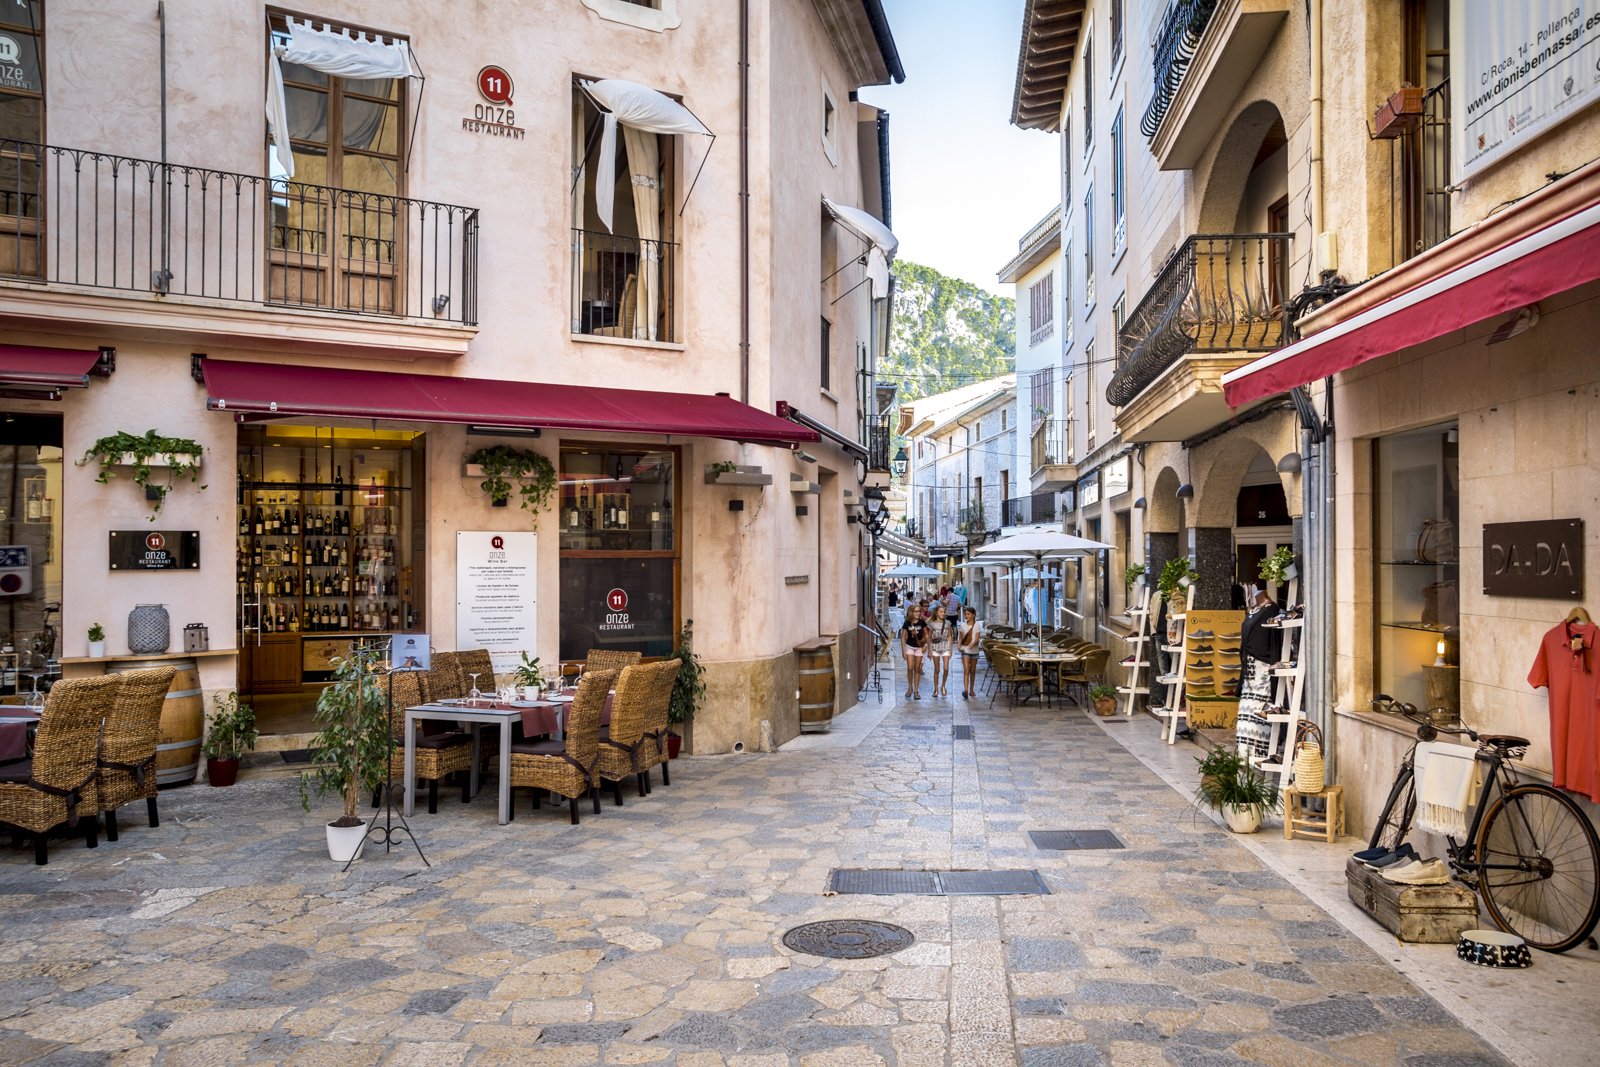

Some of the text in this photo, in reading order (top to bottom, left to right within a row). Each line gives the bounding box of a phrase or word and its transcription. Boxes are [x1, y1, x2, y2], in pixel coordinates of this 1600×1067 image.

[1518, 42, 1528, 58] 14
[1537, 7, 1580, 46] Pollença
[1467, 11, 1600, 115] www.dionisbennassar.es
[487, 77, 502, 93] 11
[475, 103, 515, 126] onze
[462, 119, 525, 140] RESTAURANT
[489, 551, 506, 559] onze
[1490, 542, 1573, 577] DA-DA
[613, 596, 621, 604] 11
[606, 613, 629, 624] onze
